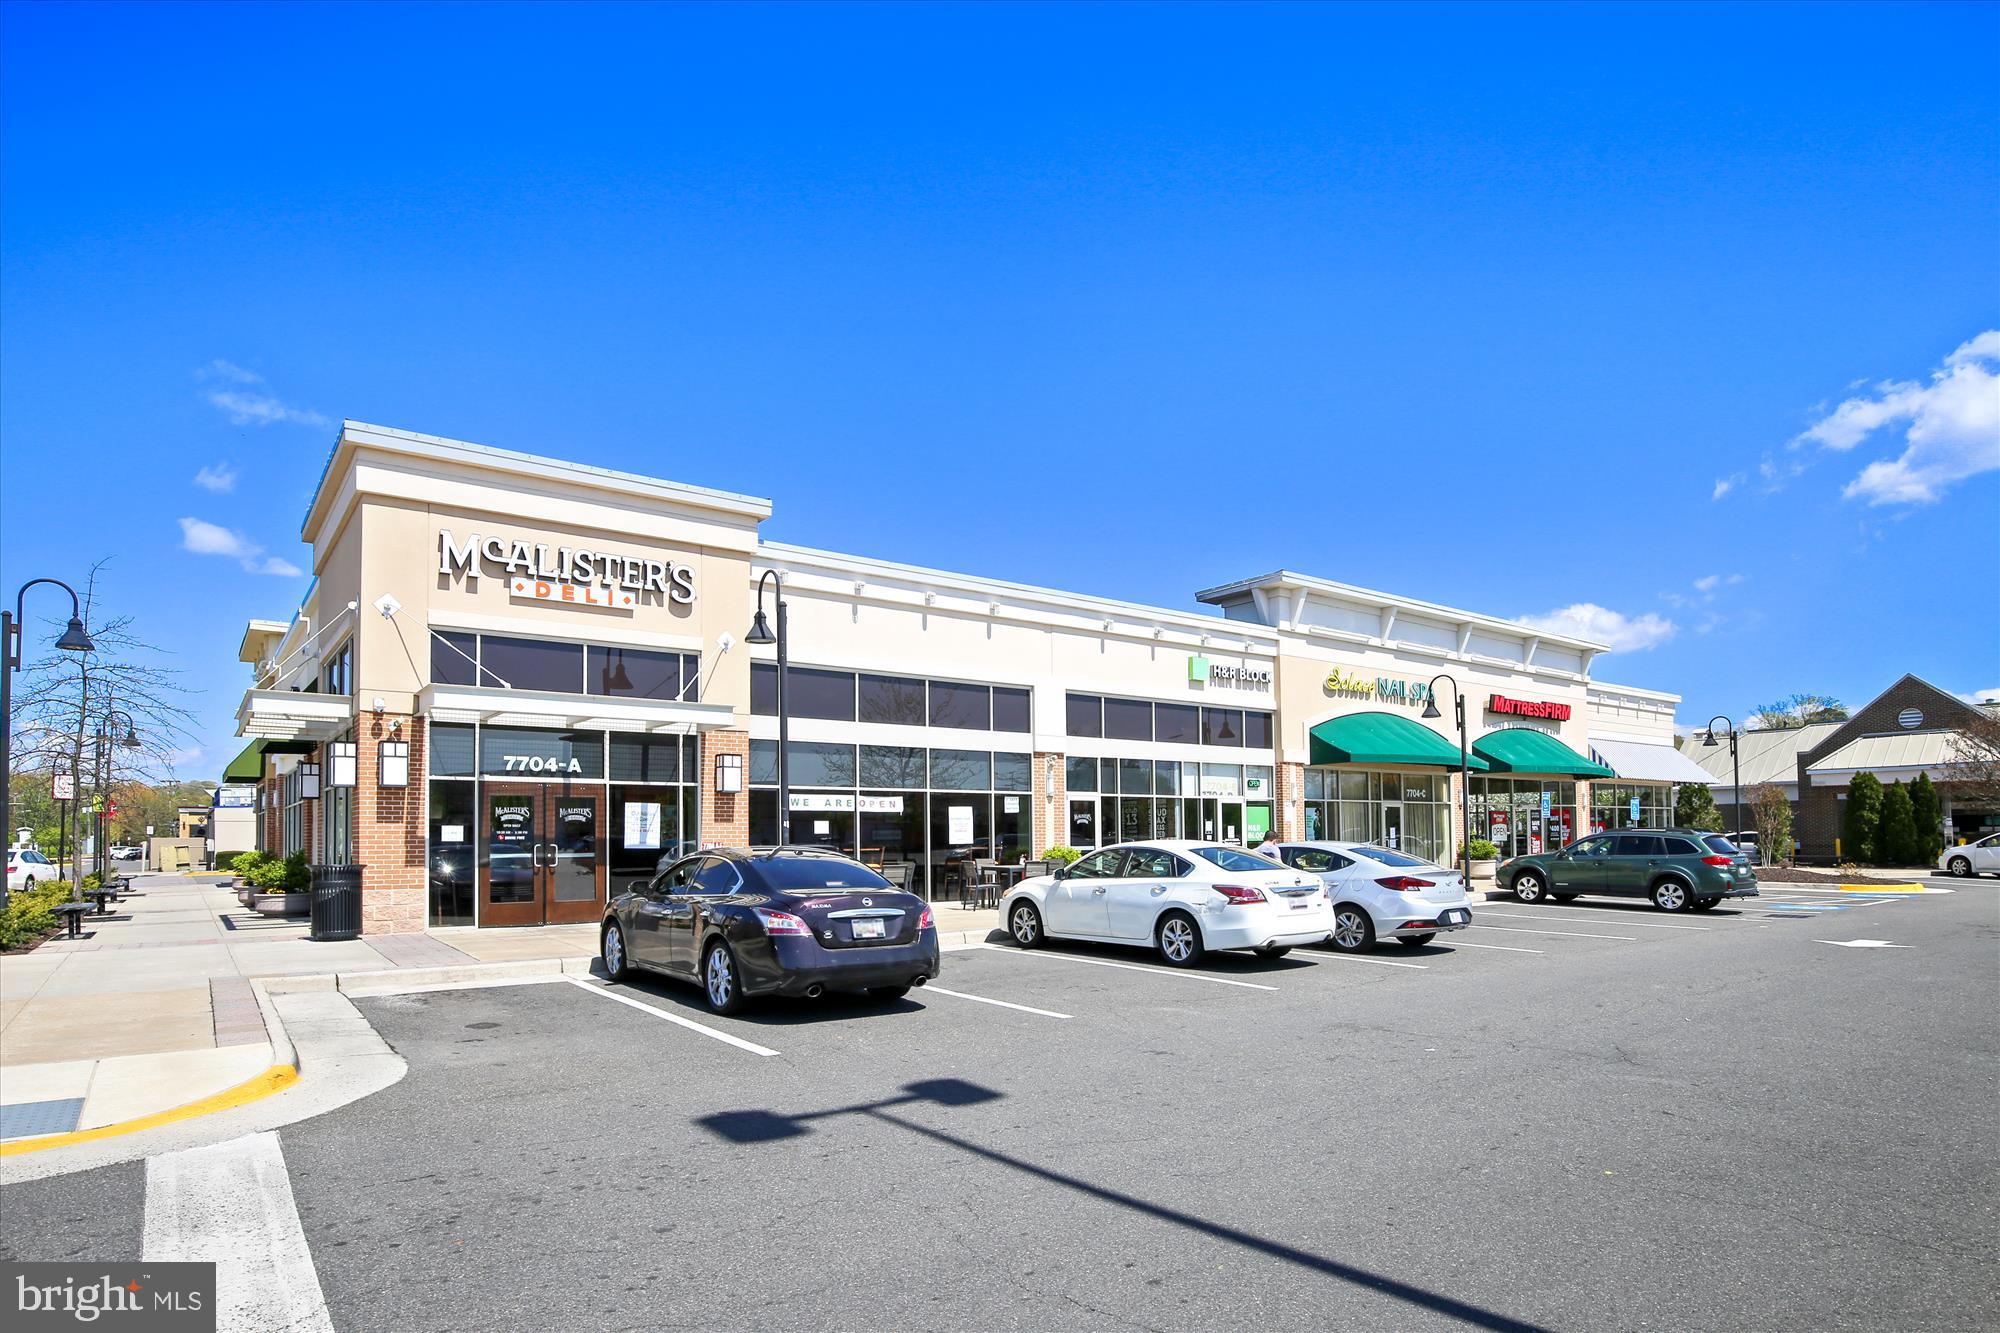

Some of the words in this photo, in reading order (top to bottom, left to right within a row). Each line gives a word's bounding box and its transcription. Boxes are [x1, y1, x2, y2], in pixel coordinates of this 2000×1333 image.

[535, 581, 614, 606] DELI
[1213, 665, 1237, 680] H&R
[1239, 668, 1273, 683] BLOCK
[1325, 666, 1375, 694] Solace
[1377, 677, 1410, 699] NAIL
[503, 755, 582, 773] 7704-A
[1407, 788, 1426, 798] 7704-C
[790, 798, 809, 807] WE
[825, 798, 853, 807] ARE
[858, 799, 896, 808] OPEN
[1247, 832, 1266, 840] BLOC
[1493, 827, 1507, 836] OPEN
